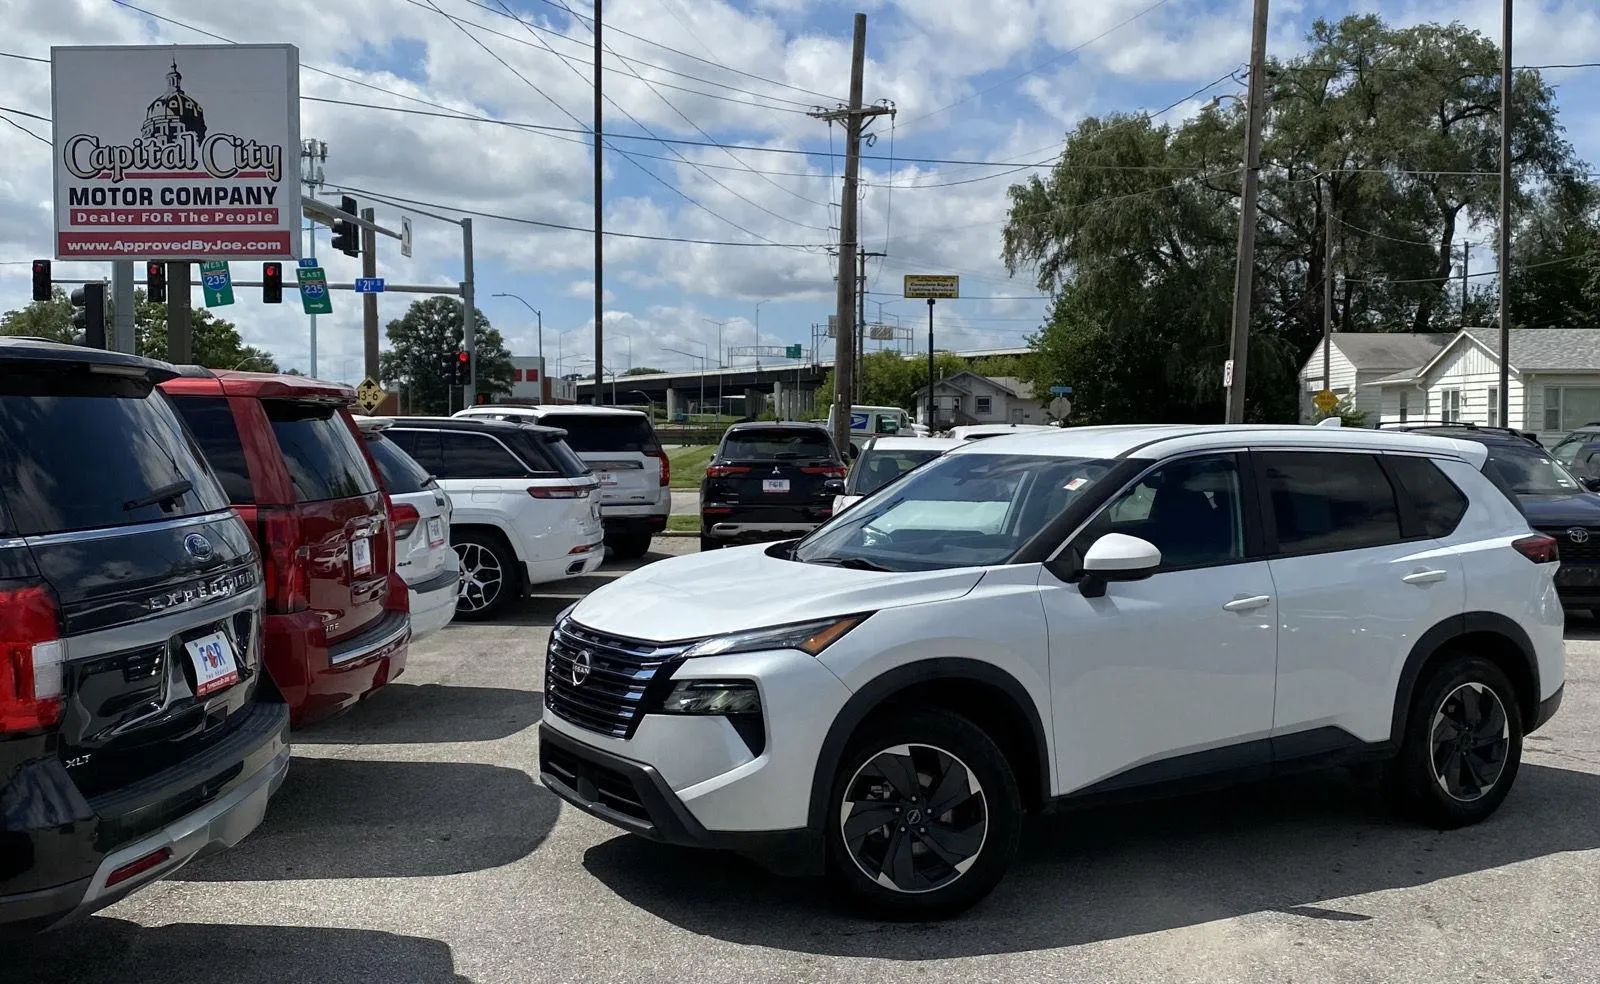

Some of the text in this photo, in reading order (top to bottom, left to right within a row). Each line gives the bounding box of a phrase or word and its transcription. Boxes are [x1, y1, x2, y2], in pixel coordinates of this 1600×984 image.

[64, 132, 282, 184] Capital City
[69, 186, 278, 206] MOTOR COMPANY
[77, 211, 273, 224] Dealer FOR The People
[67, 240, 281, 252] www.ApprovedByJoe.com
[202, 261, 225, 270] WEST
[207, 275, 226, 286] 235
[305, 284, 324, 294] 235
[199, 642, 227, 672] FOR
[65, 753, 92, 769] XLT
